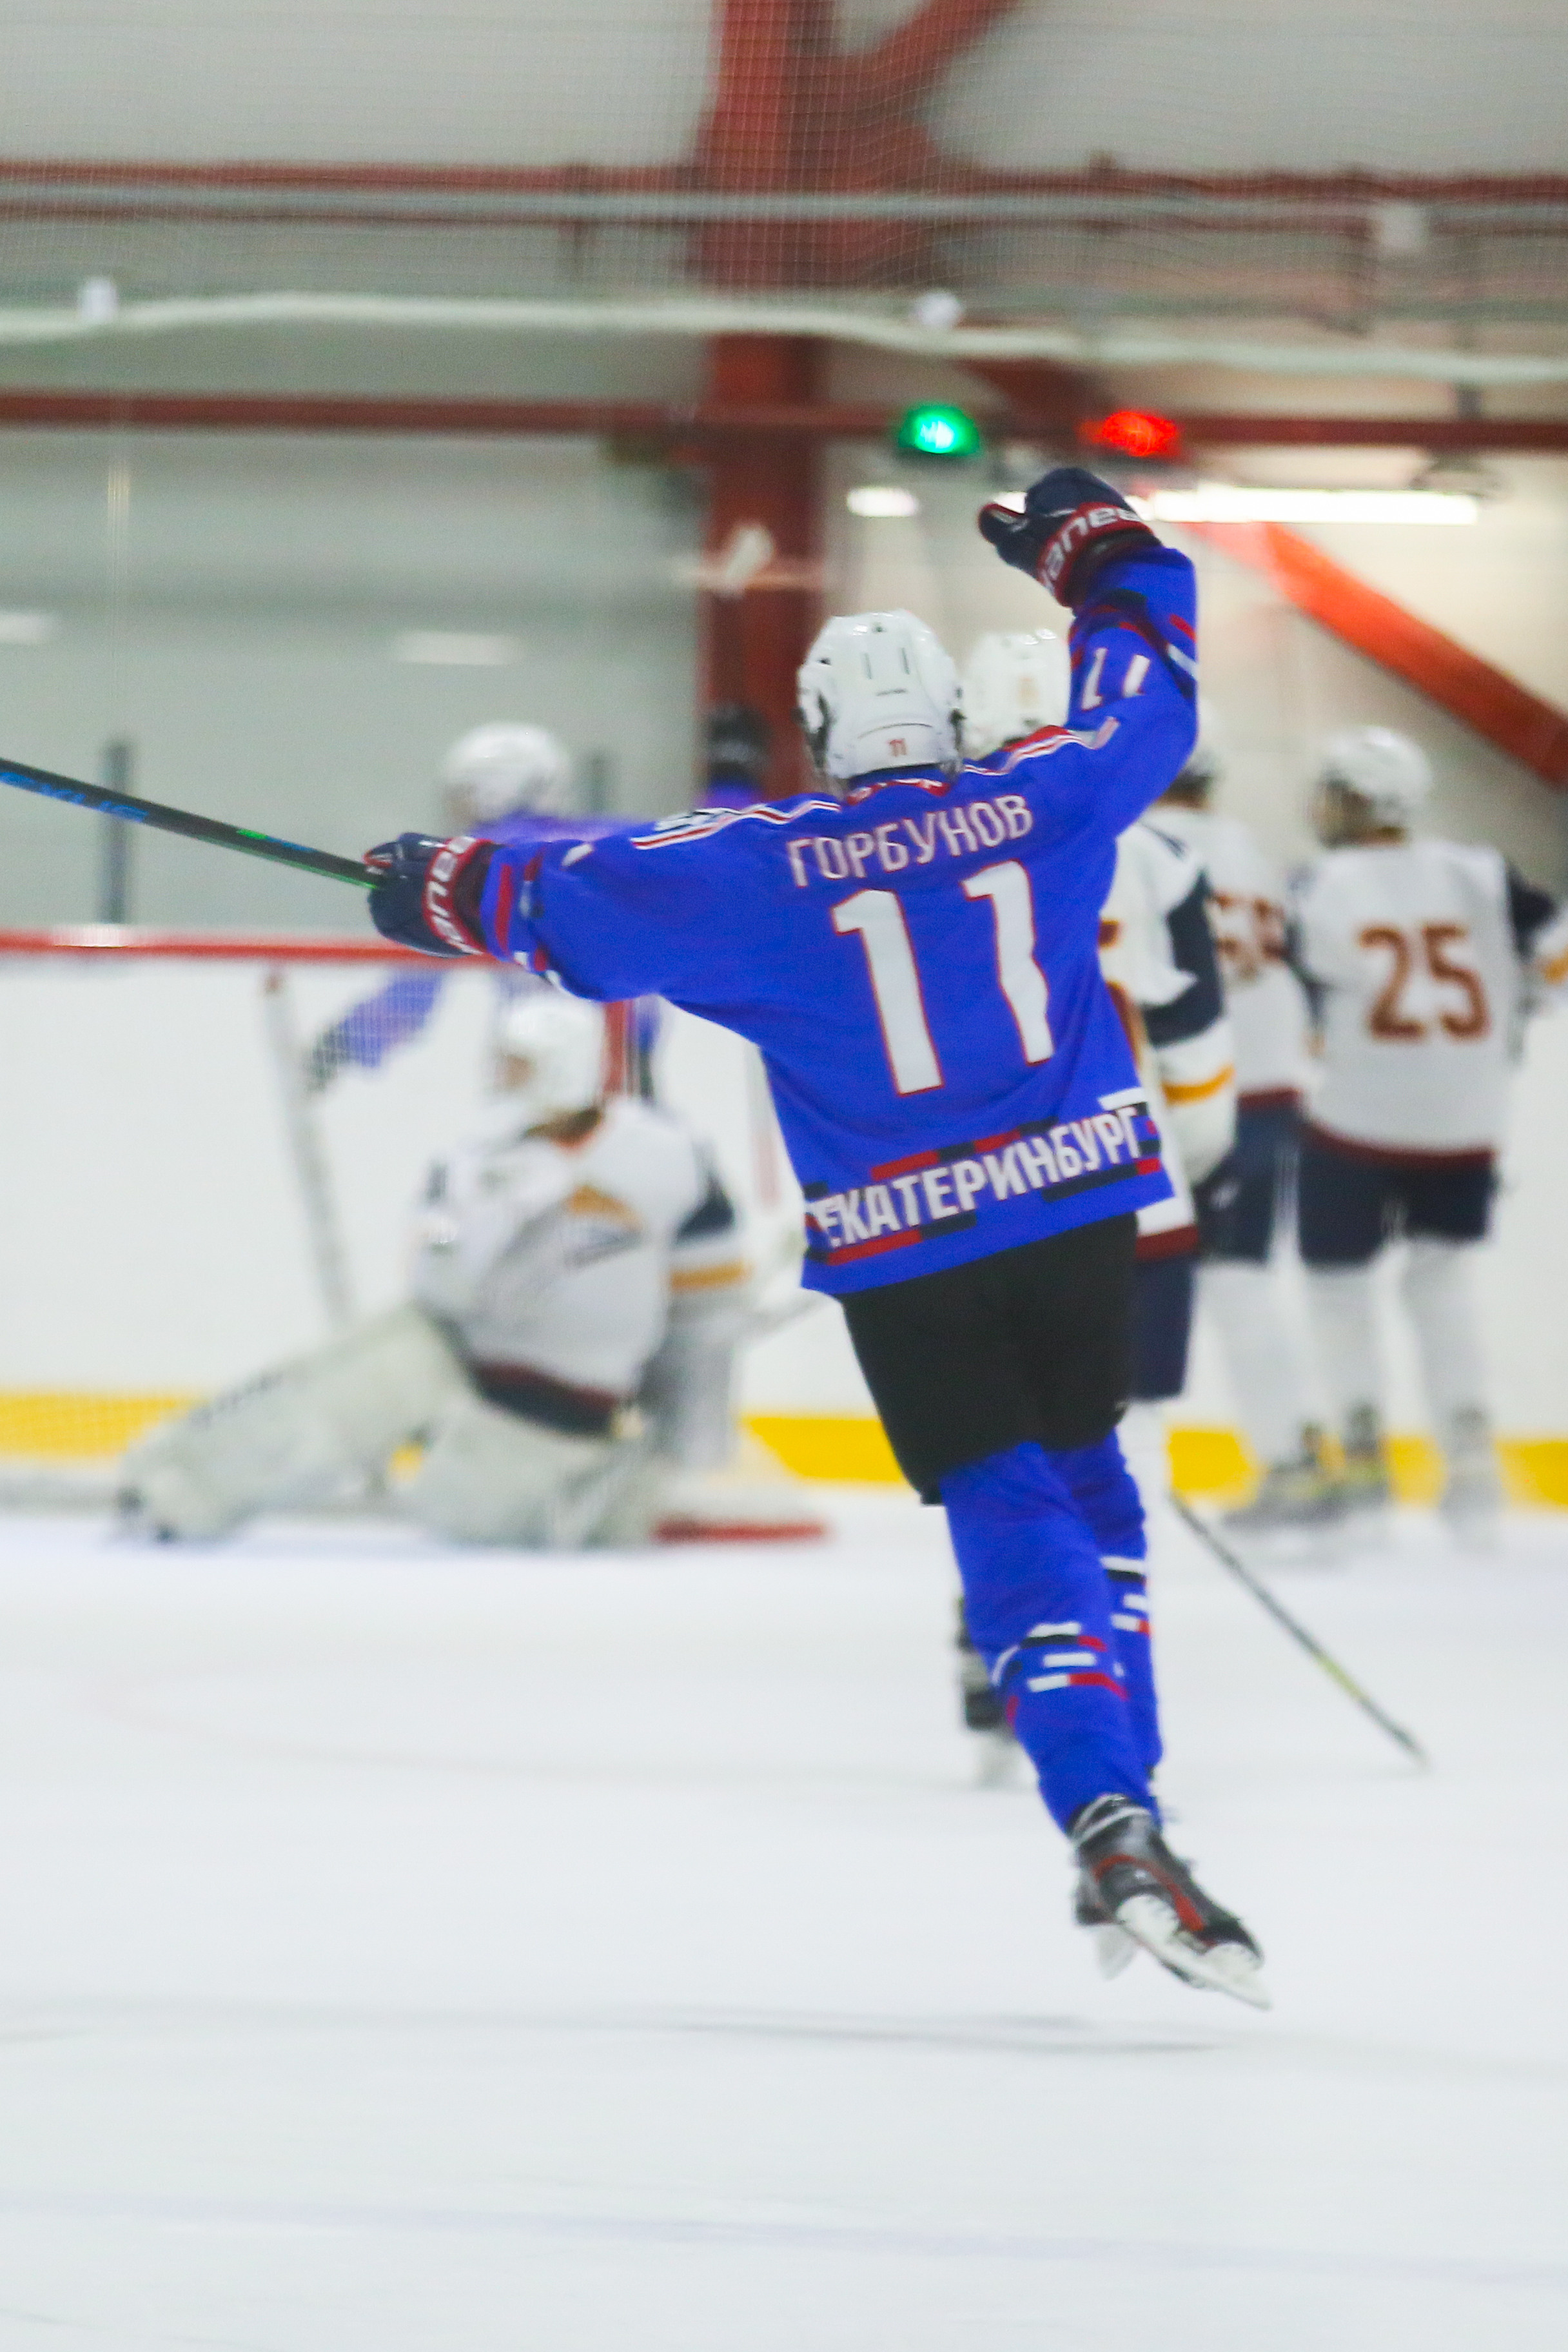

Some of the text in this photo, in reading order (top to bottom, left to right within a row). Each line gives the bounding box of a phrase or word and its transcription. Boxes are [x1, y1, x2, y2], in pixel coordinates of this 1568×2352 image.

[786, 794, 1034, 888] ГОРБУНОВ
[831, 859, 1055, 1097] 11
[1359, 921, 1491, 1042] 25
[811, 1106, 1140, 1248] ЕКАТЕРИНБУРГ
